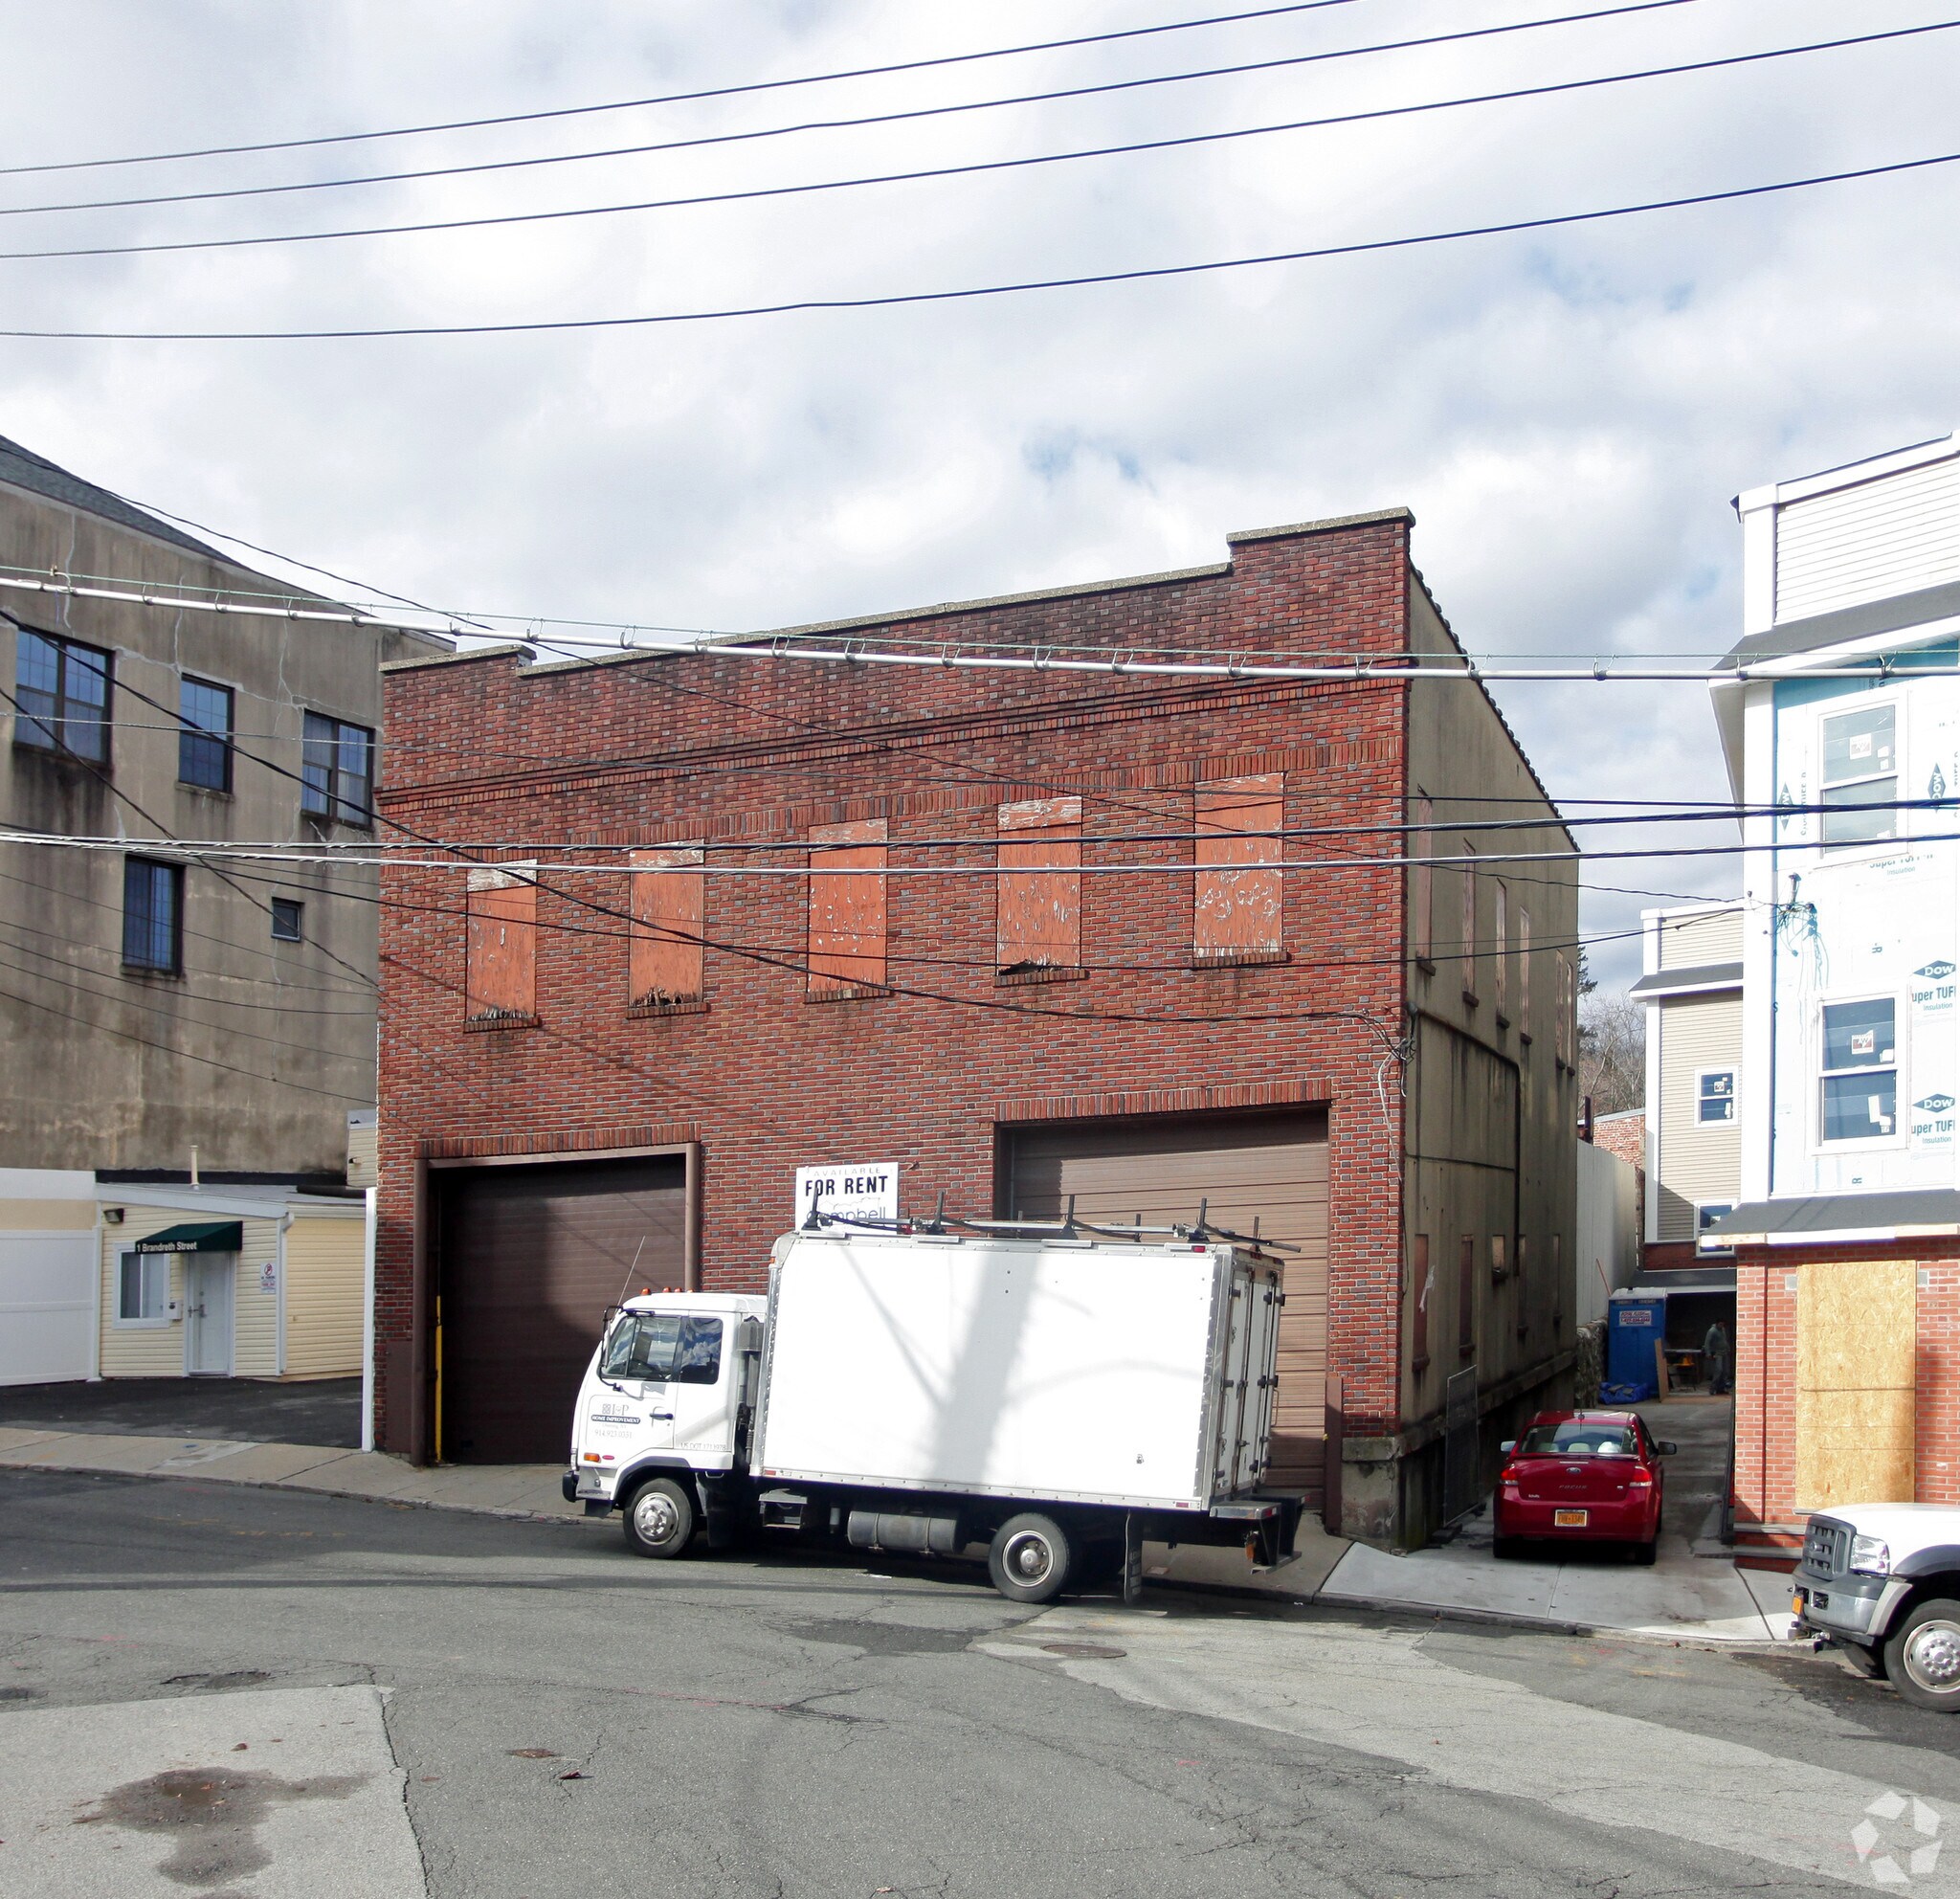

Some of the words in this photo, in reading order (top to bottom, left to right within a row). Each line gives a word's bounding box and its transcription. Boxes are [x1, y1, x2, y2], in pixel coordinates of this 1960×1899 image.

[1924, 965, 1954, 976] DOW
[1923, 1099, 1953, 1109] DOW
[813, 1166, 880, 1177] AVAILABLE
[805, 1178, 835, 1196] FOR
[844, 1175, 888, 1195] RENT
[136, 1243, 141, 1253] 1
[142, 1242, 176, 1253] Brandreth
[176, 1240, 197, 1251] Street
